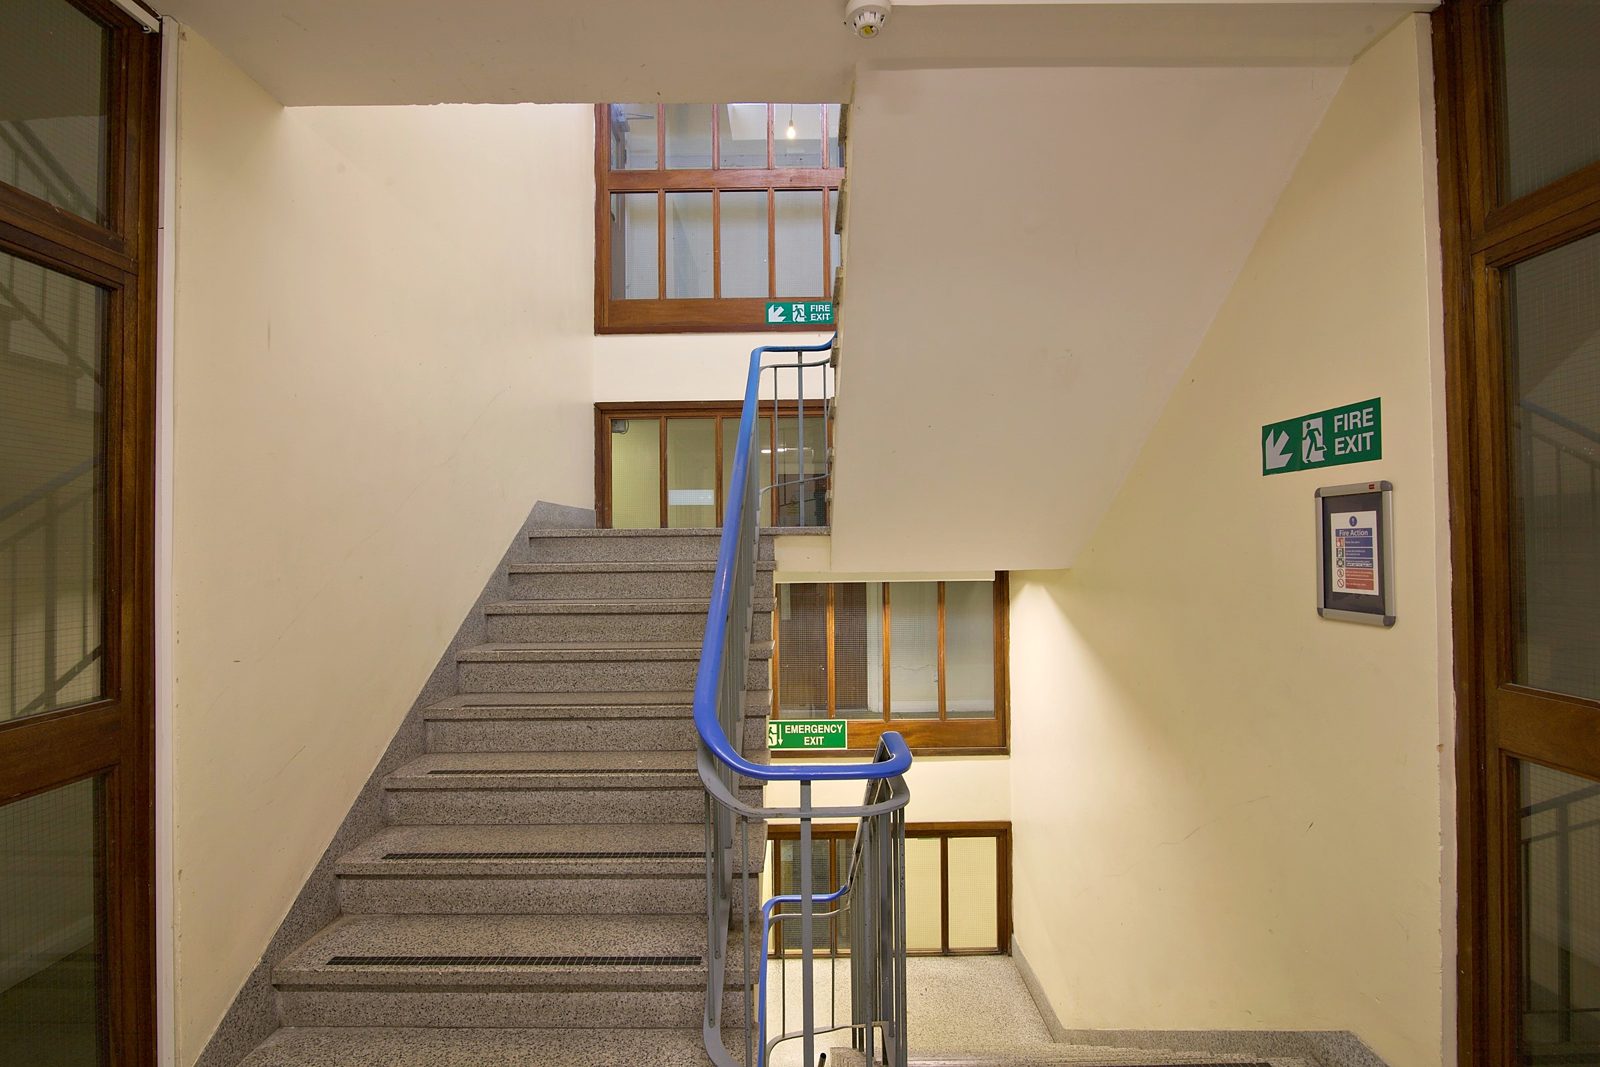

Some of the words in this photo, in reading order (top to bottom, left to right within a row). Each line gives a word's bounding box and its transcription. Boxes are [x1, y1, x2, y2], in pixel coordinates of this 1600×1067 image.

[1334, 408, 1374, 432] FIRE
[1335, 432, 1374, 456] EXIT
[785, 724, 843, 734] EMERGENCY
[804, 736, 824, 745] EXIT
